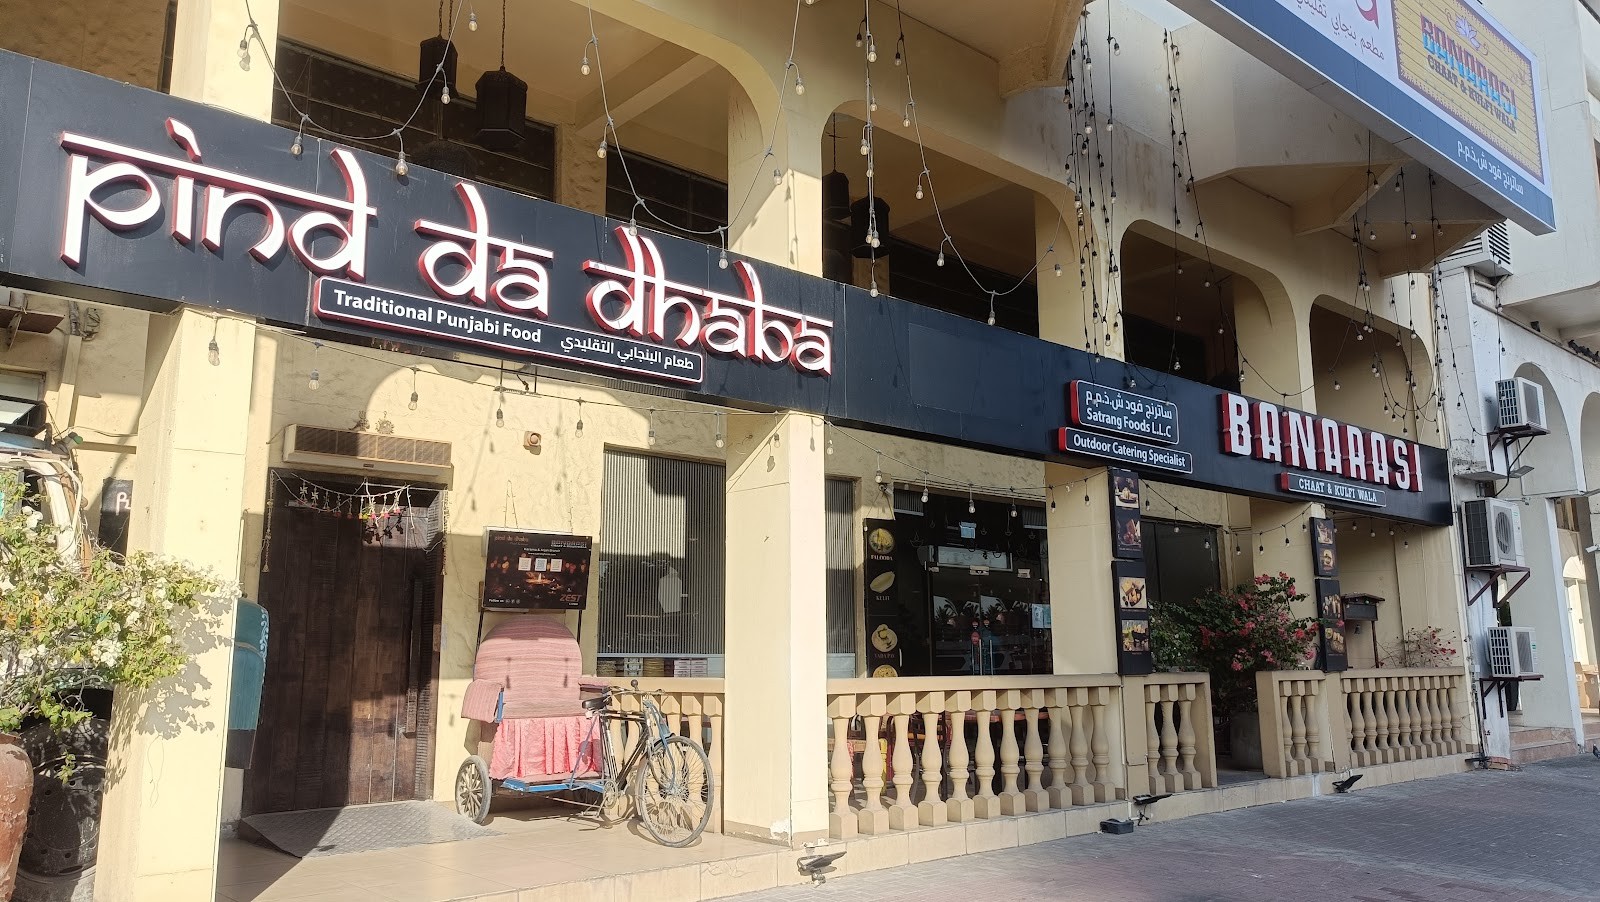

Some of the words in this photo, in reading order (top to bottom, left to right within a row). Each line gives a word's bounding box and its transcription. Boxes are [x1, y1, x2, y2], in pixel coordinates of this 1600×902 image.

[1361, 36, 1384, 60] مطعم
[1420, 12, 1518, 120] BANARASI
[1460, 79, 1468, 96] &
[1489, 162, 1502, 181] فود
[60, 117, 377, 281] pind
[414, 180, 554, 319] da
[582, 226, 834, 377] dhaba
[334, 289, 433, 323] Traditional
[436, 309, 500, 335] Punjabi
[502, 322, 542, 344] Food
[560, 336, 615, 354] التقليدي
[616, 346, 662, 364] البنجابي
[663, 354, 694, 370] طعام
[1125, 399, 1144, 415] فود
[1145, 403, 1173, 420] ساترنج
[1086, 407, 1122, 430] Satrang
[1123, 415, 1151, 433] Foods
[1151, 421, 1172, 438] L.L.C
[1073, 433, 1111, 453] Outdoor
[1112, 441, 1148, 463] Catering
[1148, 449, 1186, 468] Specialist
[1222, 392, 1424, 492] BANARASI
[1298, 478, 1325, 494] CHAAT
[1327, 484, 1333, 494] &
[1334, 485, 1356, 499] KULFI
[1357, 488, 1378, 503] WALA
[560, 594, 582, 602] ZEST
